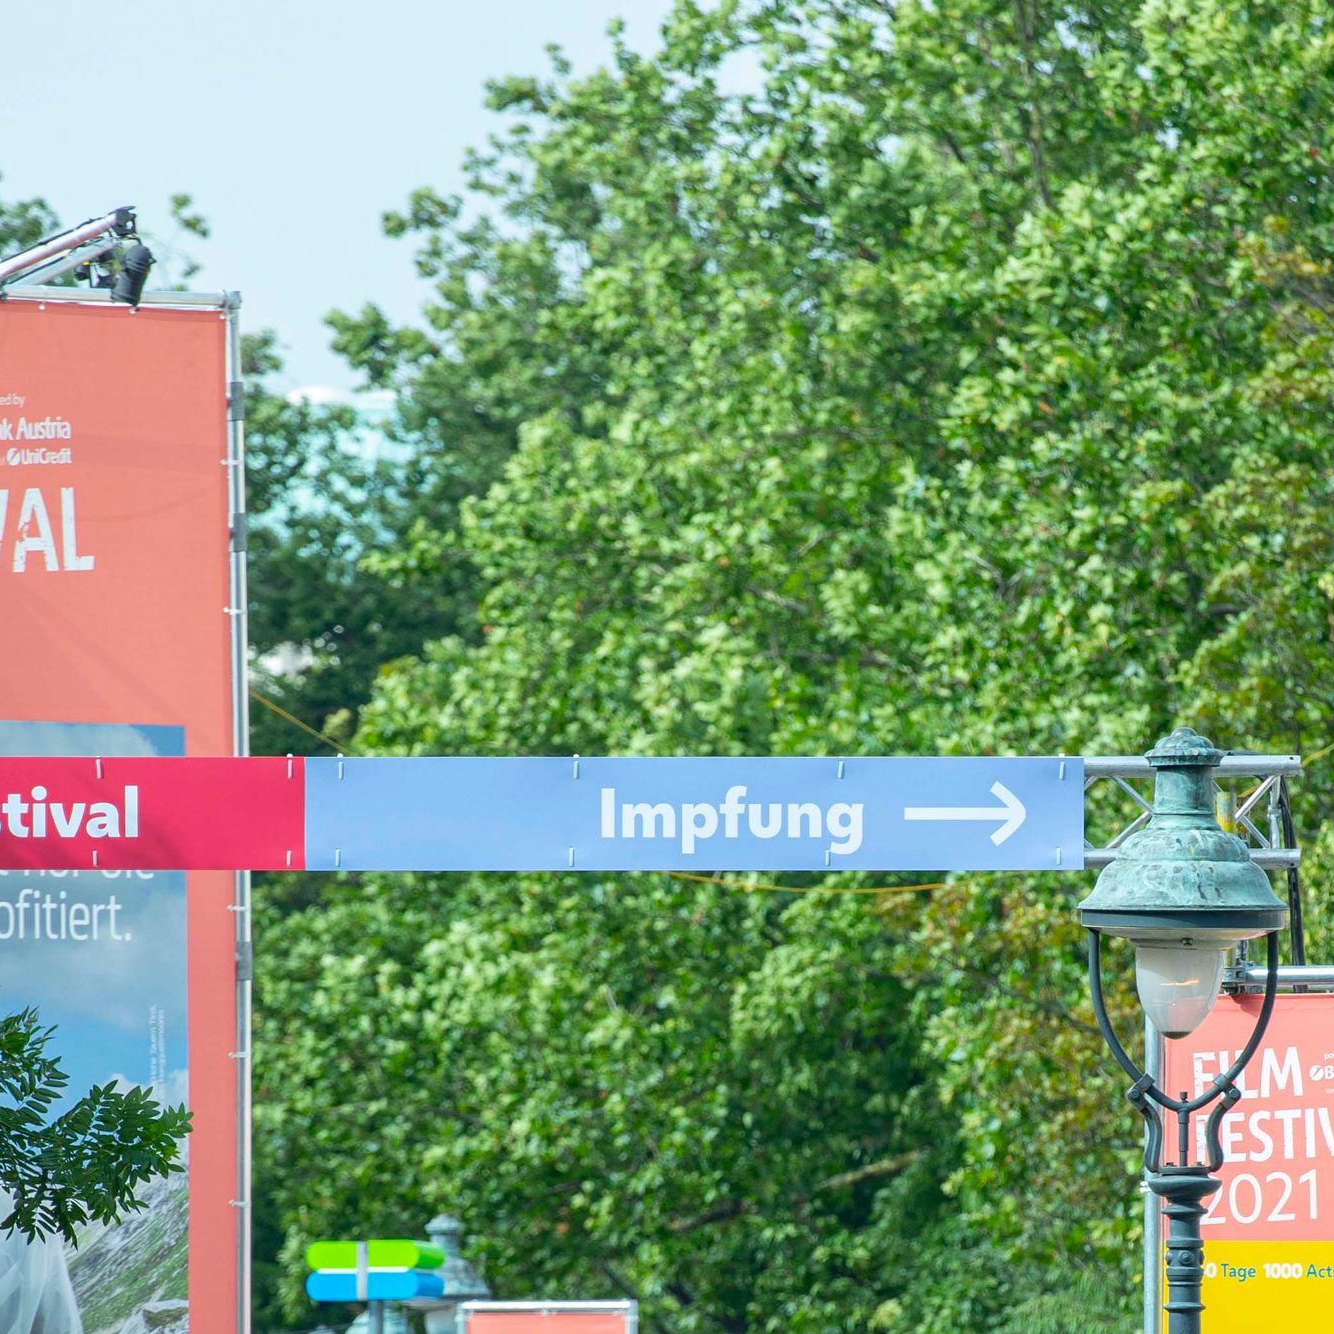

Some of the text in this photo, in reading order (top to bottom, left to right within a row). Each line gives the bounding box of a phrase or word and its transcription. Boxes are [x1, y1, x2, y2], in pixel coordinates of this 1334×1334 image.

[15, 416, 71, 441] Austria
[20, 447, 72, 465] UniCredit
[601, 785, 864, 855] Impfung
[1220, 1263, 1257, 1282] Tage
[1263, 1263, 1303, 1279] 1000
